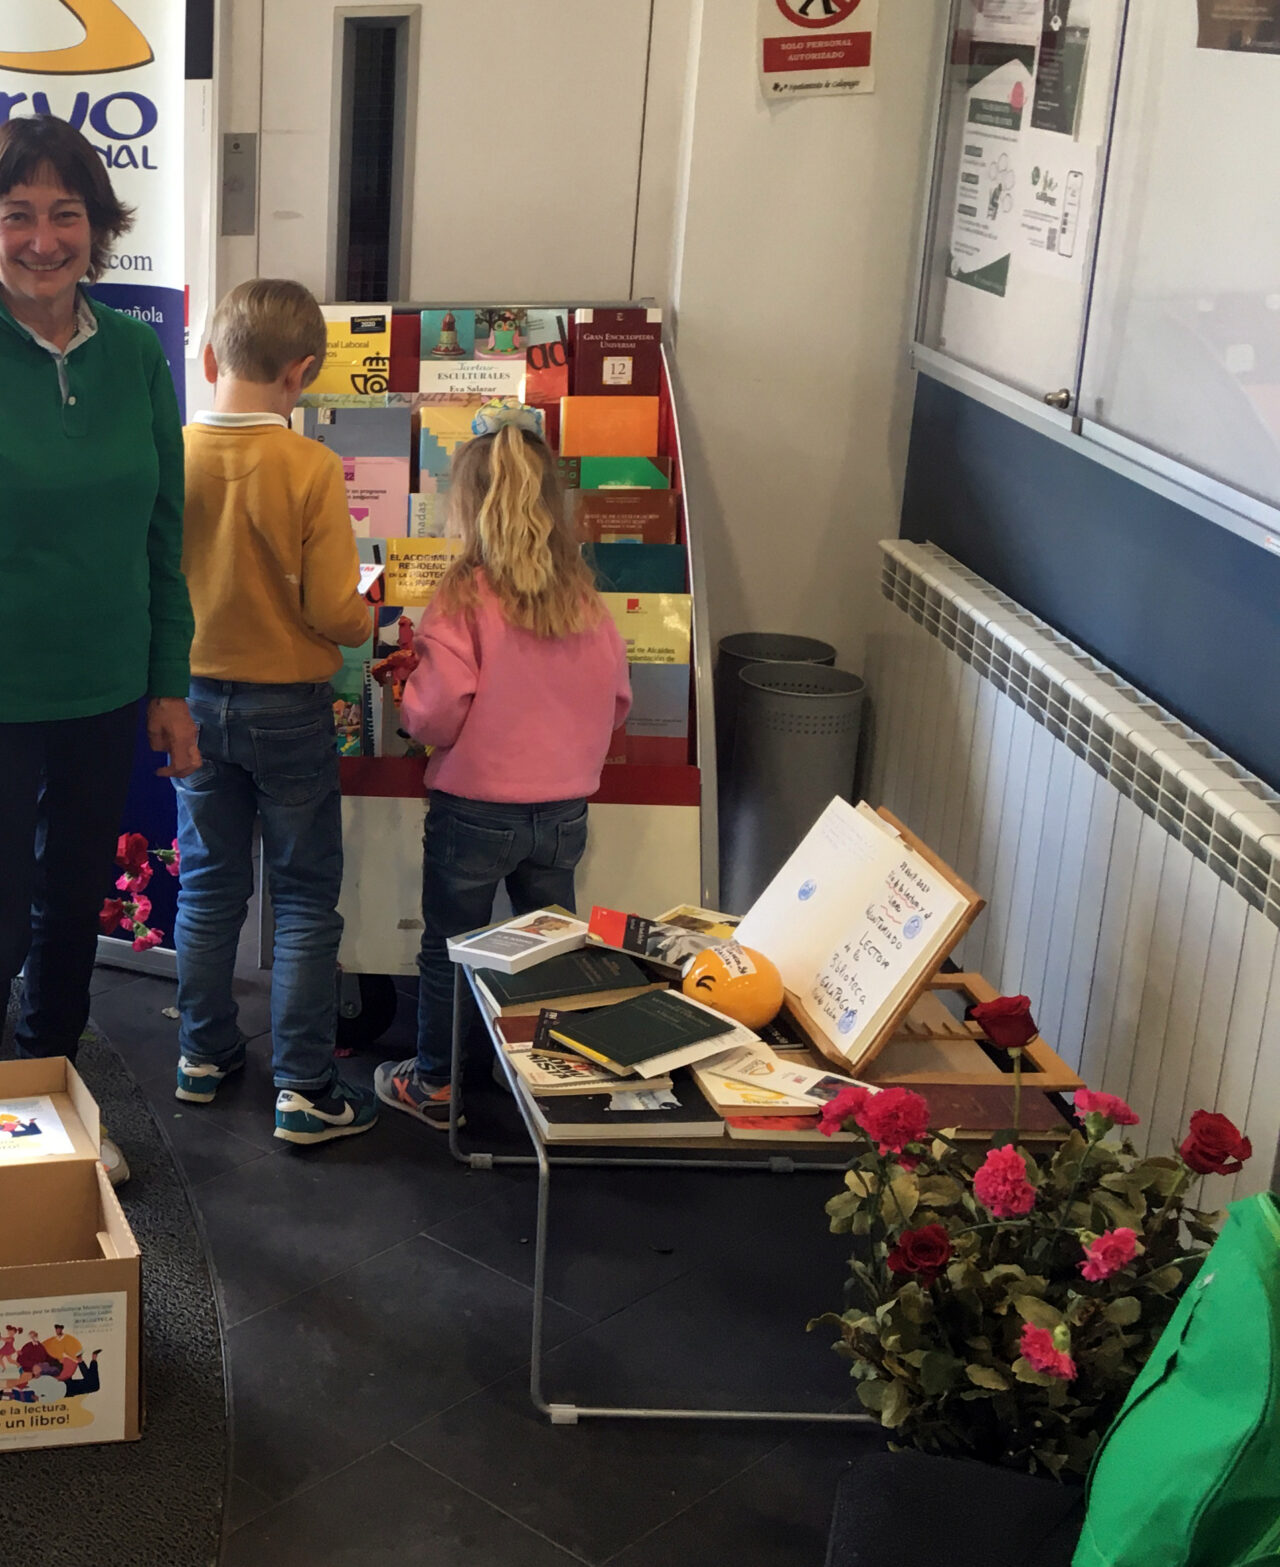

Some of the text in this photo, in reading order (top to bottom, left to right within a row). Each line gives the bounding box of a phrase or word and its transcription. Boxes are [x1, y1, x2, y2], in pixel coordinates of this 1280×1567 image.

[780, 39, 853, 50] SOLO PERSONAL
[787, 51, 845, 61] AUTORIZADO
[340, 340, 370, 348] Laboral
[610, 363, 626, 375] 12
[466, 385, 497, 393] Salazar
[9, 1405, 21, 1415] la
[5, 1419, 26, 1429] un
[30, 1413, 70, 1427] libro!
